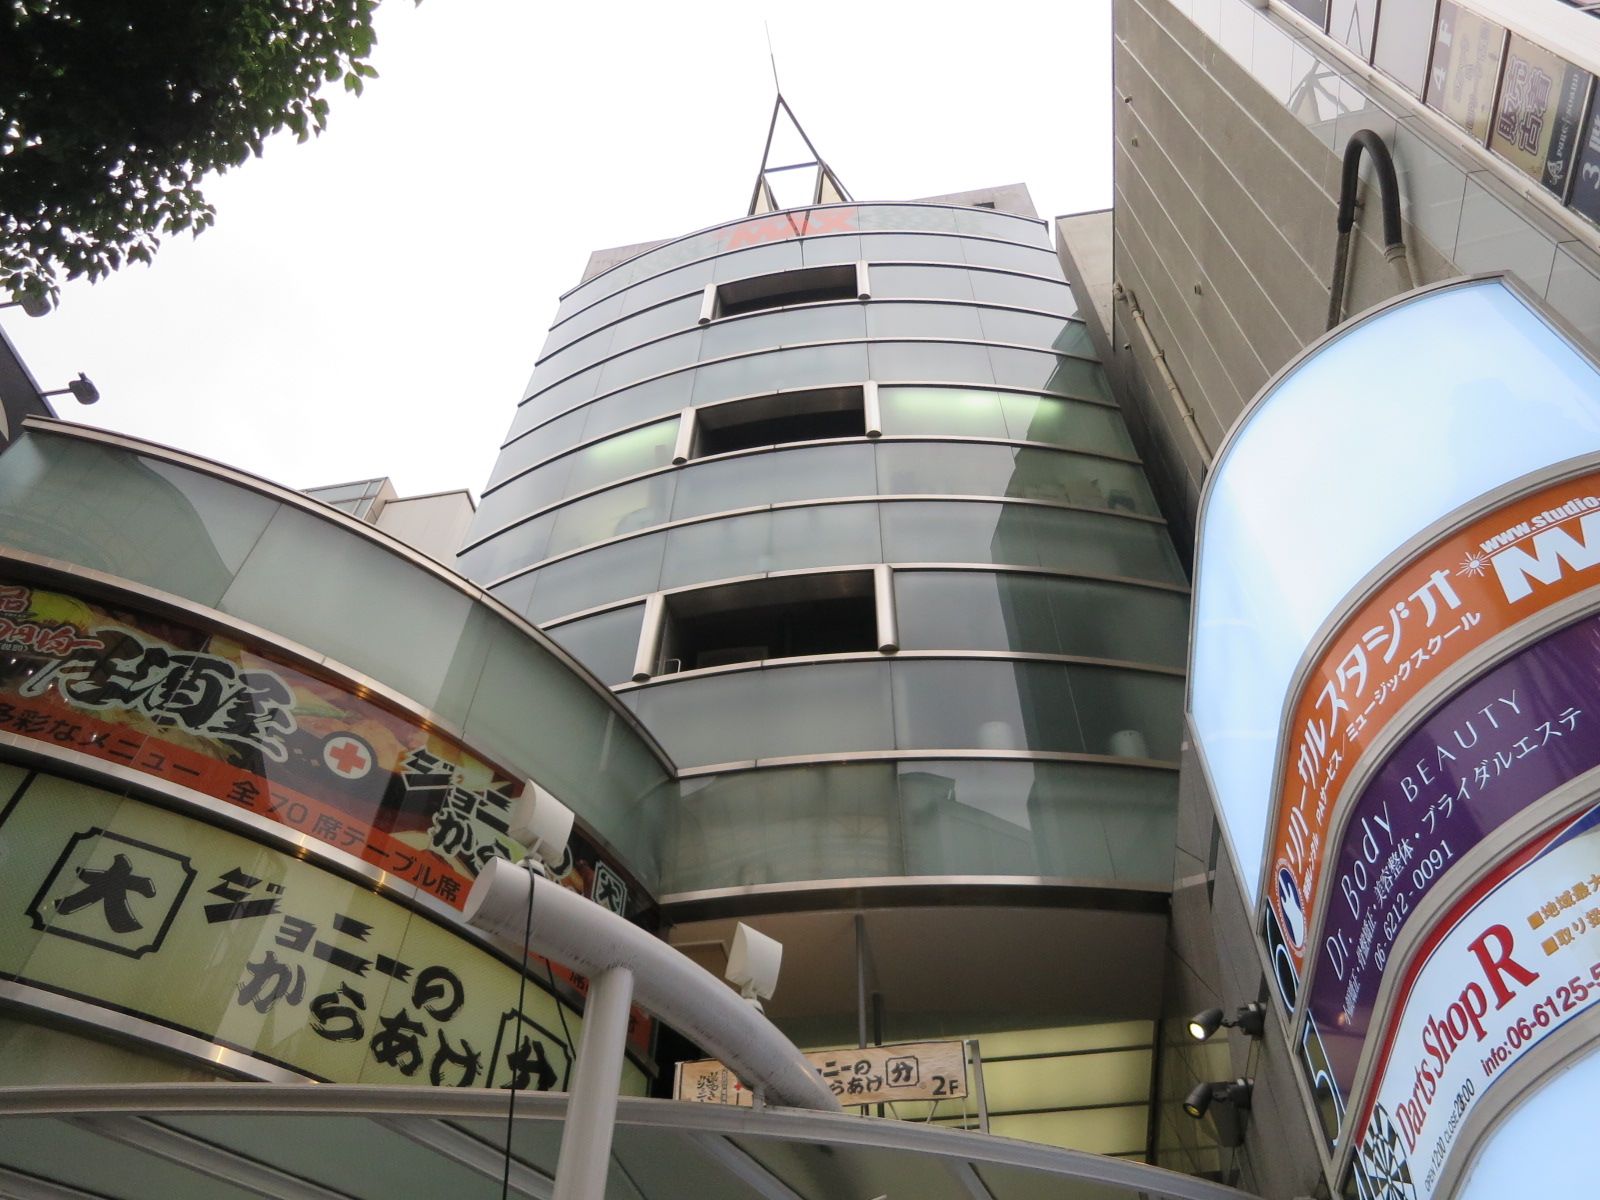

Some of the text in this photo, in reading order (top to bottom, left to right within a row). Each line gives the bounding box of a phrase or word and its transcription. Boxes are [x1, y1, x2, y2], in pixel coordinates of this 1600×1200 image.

[1326, 928, 1353, 981] Dr.
[1401, 689, 1521, 802] BEAUTY
[54, 853, 157, 934] 大
[204, 866, 465, 1022] ジョニーの
[1374, 839, 1454, 973] 06-6212-0091
[1467, 923, 1540, 1011] R
[932, 1075, 959, 1096] 2F
